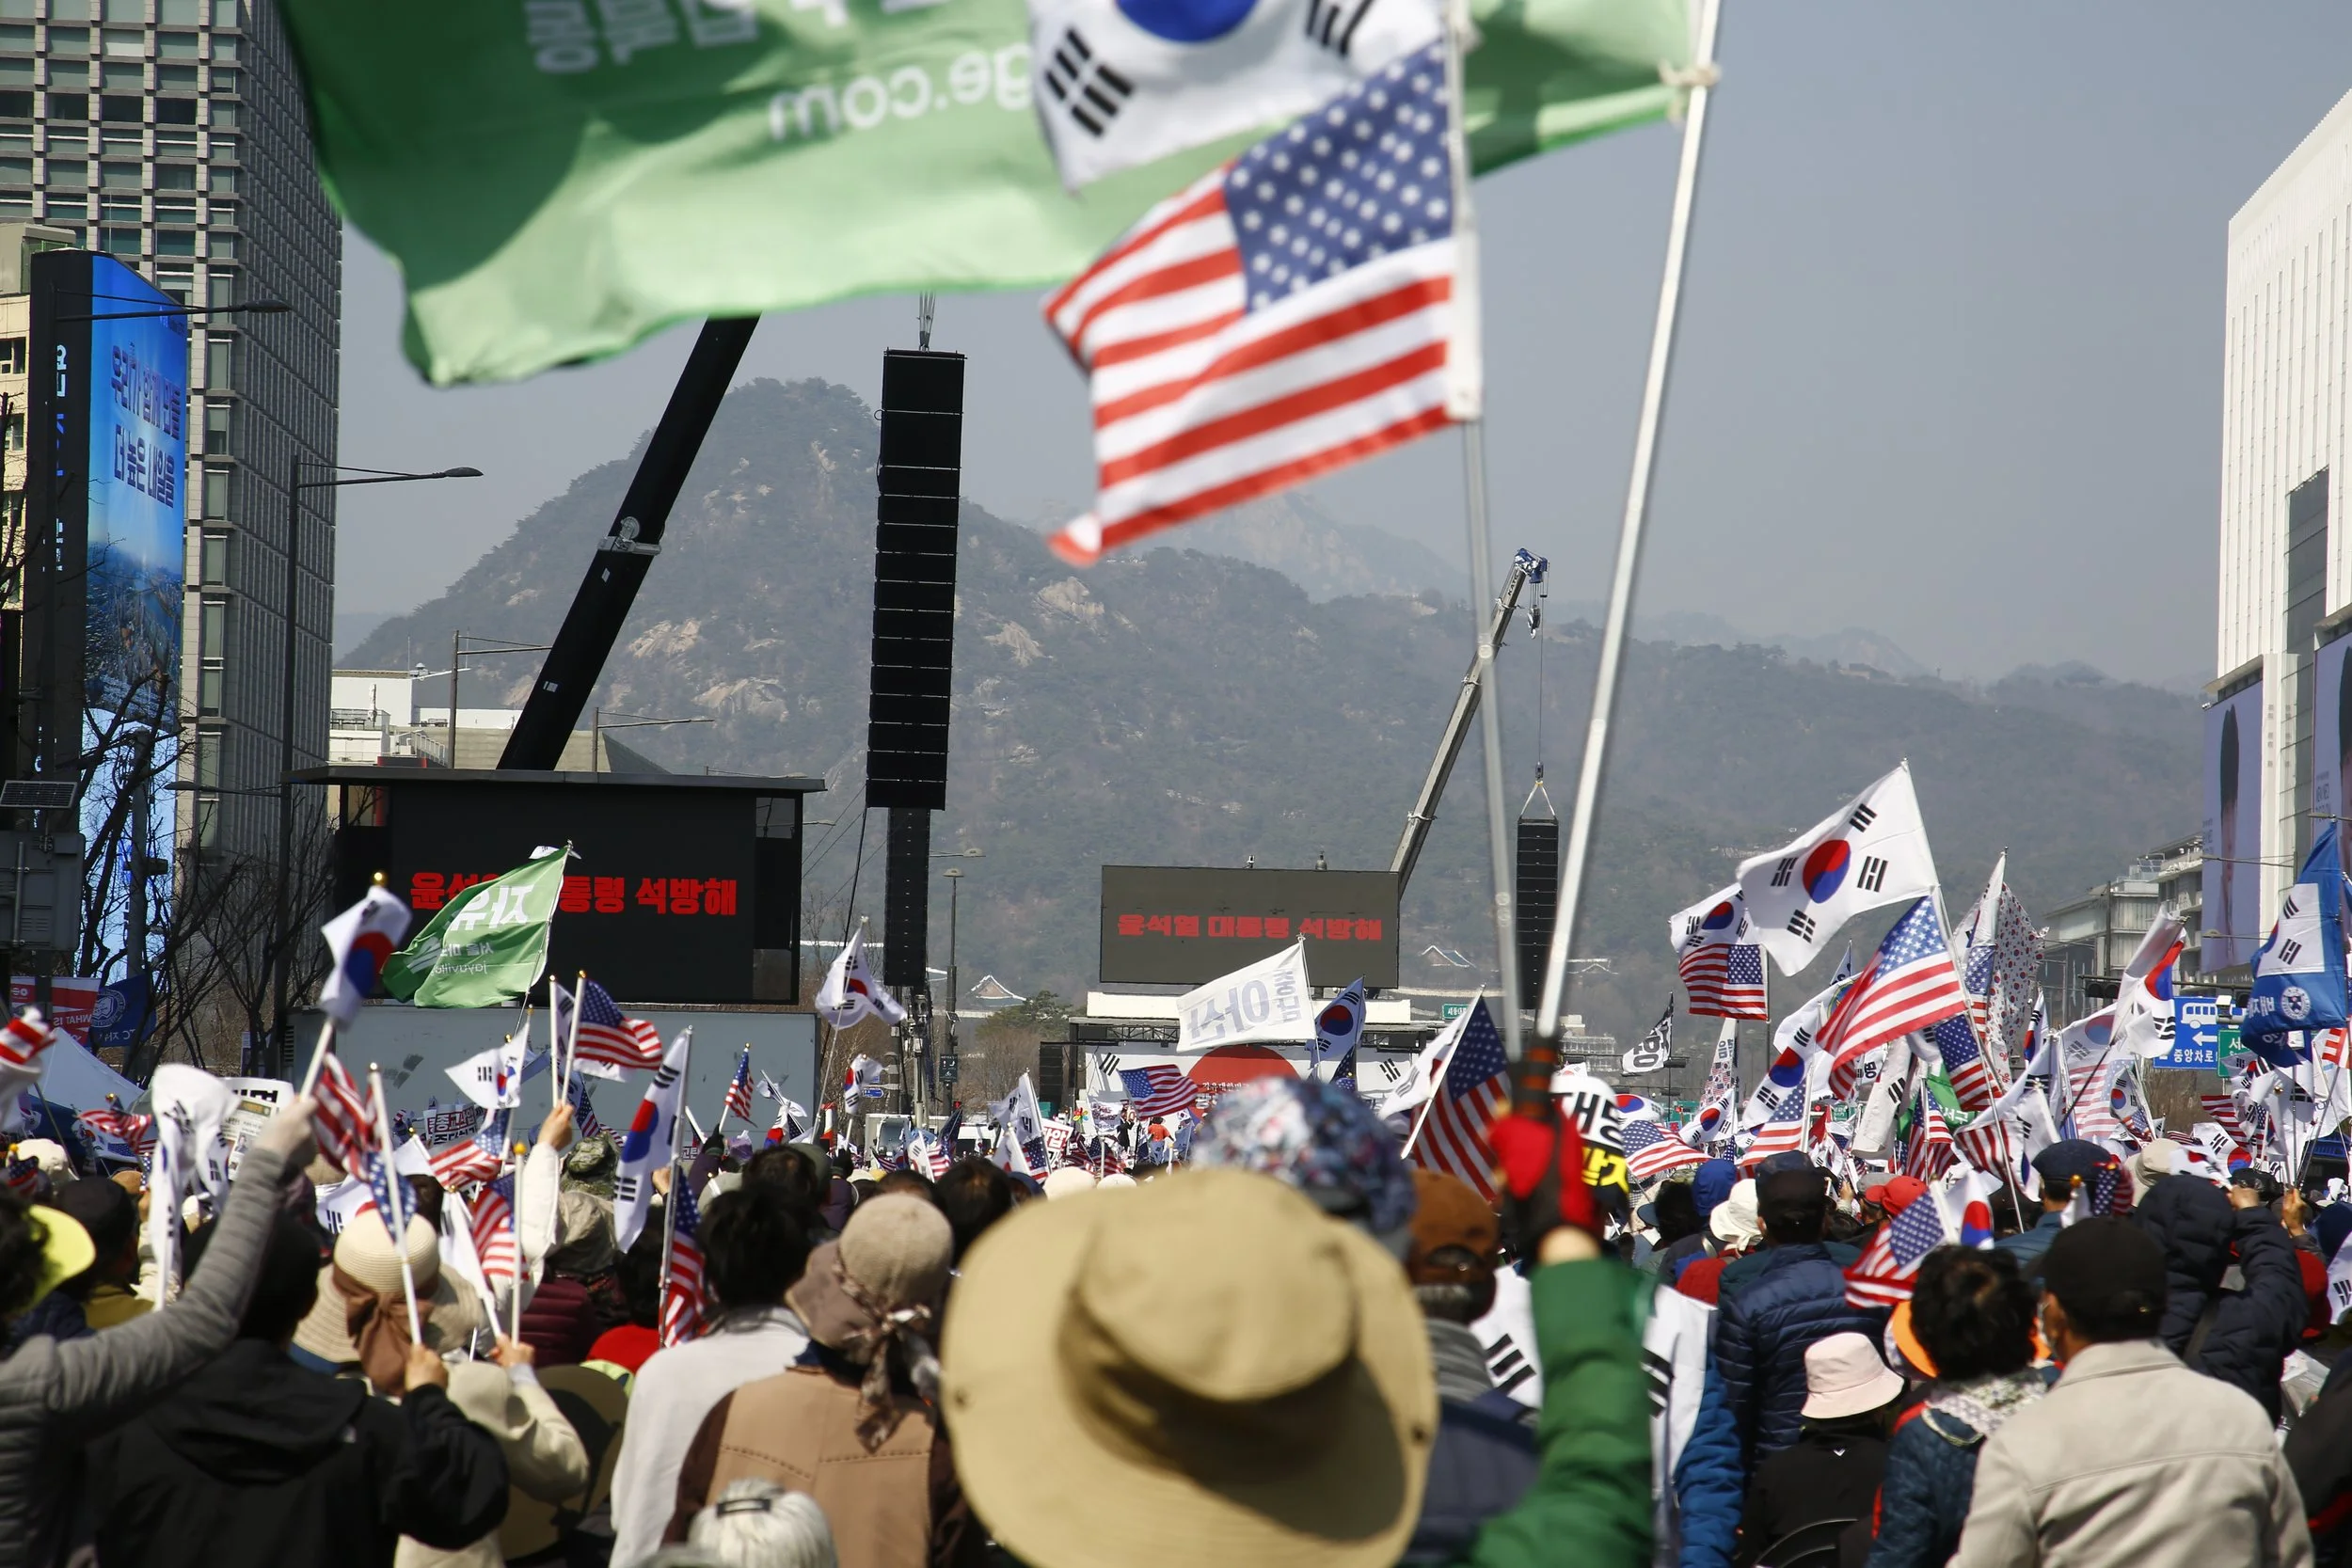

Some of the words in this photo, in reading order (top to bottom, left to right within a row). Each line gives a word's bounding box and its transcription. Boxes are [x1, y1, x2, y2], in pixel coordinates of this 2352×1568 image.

[114, 423, 125, 481] 더
[127, 430, 146, 493] 높은
[148, 443, 175, 509] 내일을
[559, 876, 625, 913] 통령
[635, 877, 738, 916] 석방해
[1117, 913, 1200, 938] 윤석열
[1207, 915, 1290, 939] 대통령
[1298, 916, 1383, 942] 석방해
